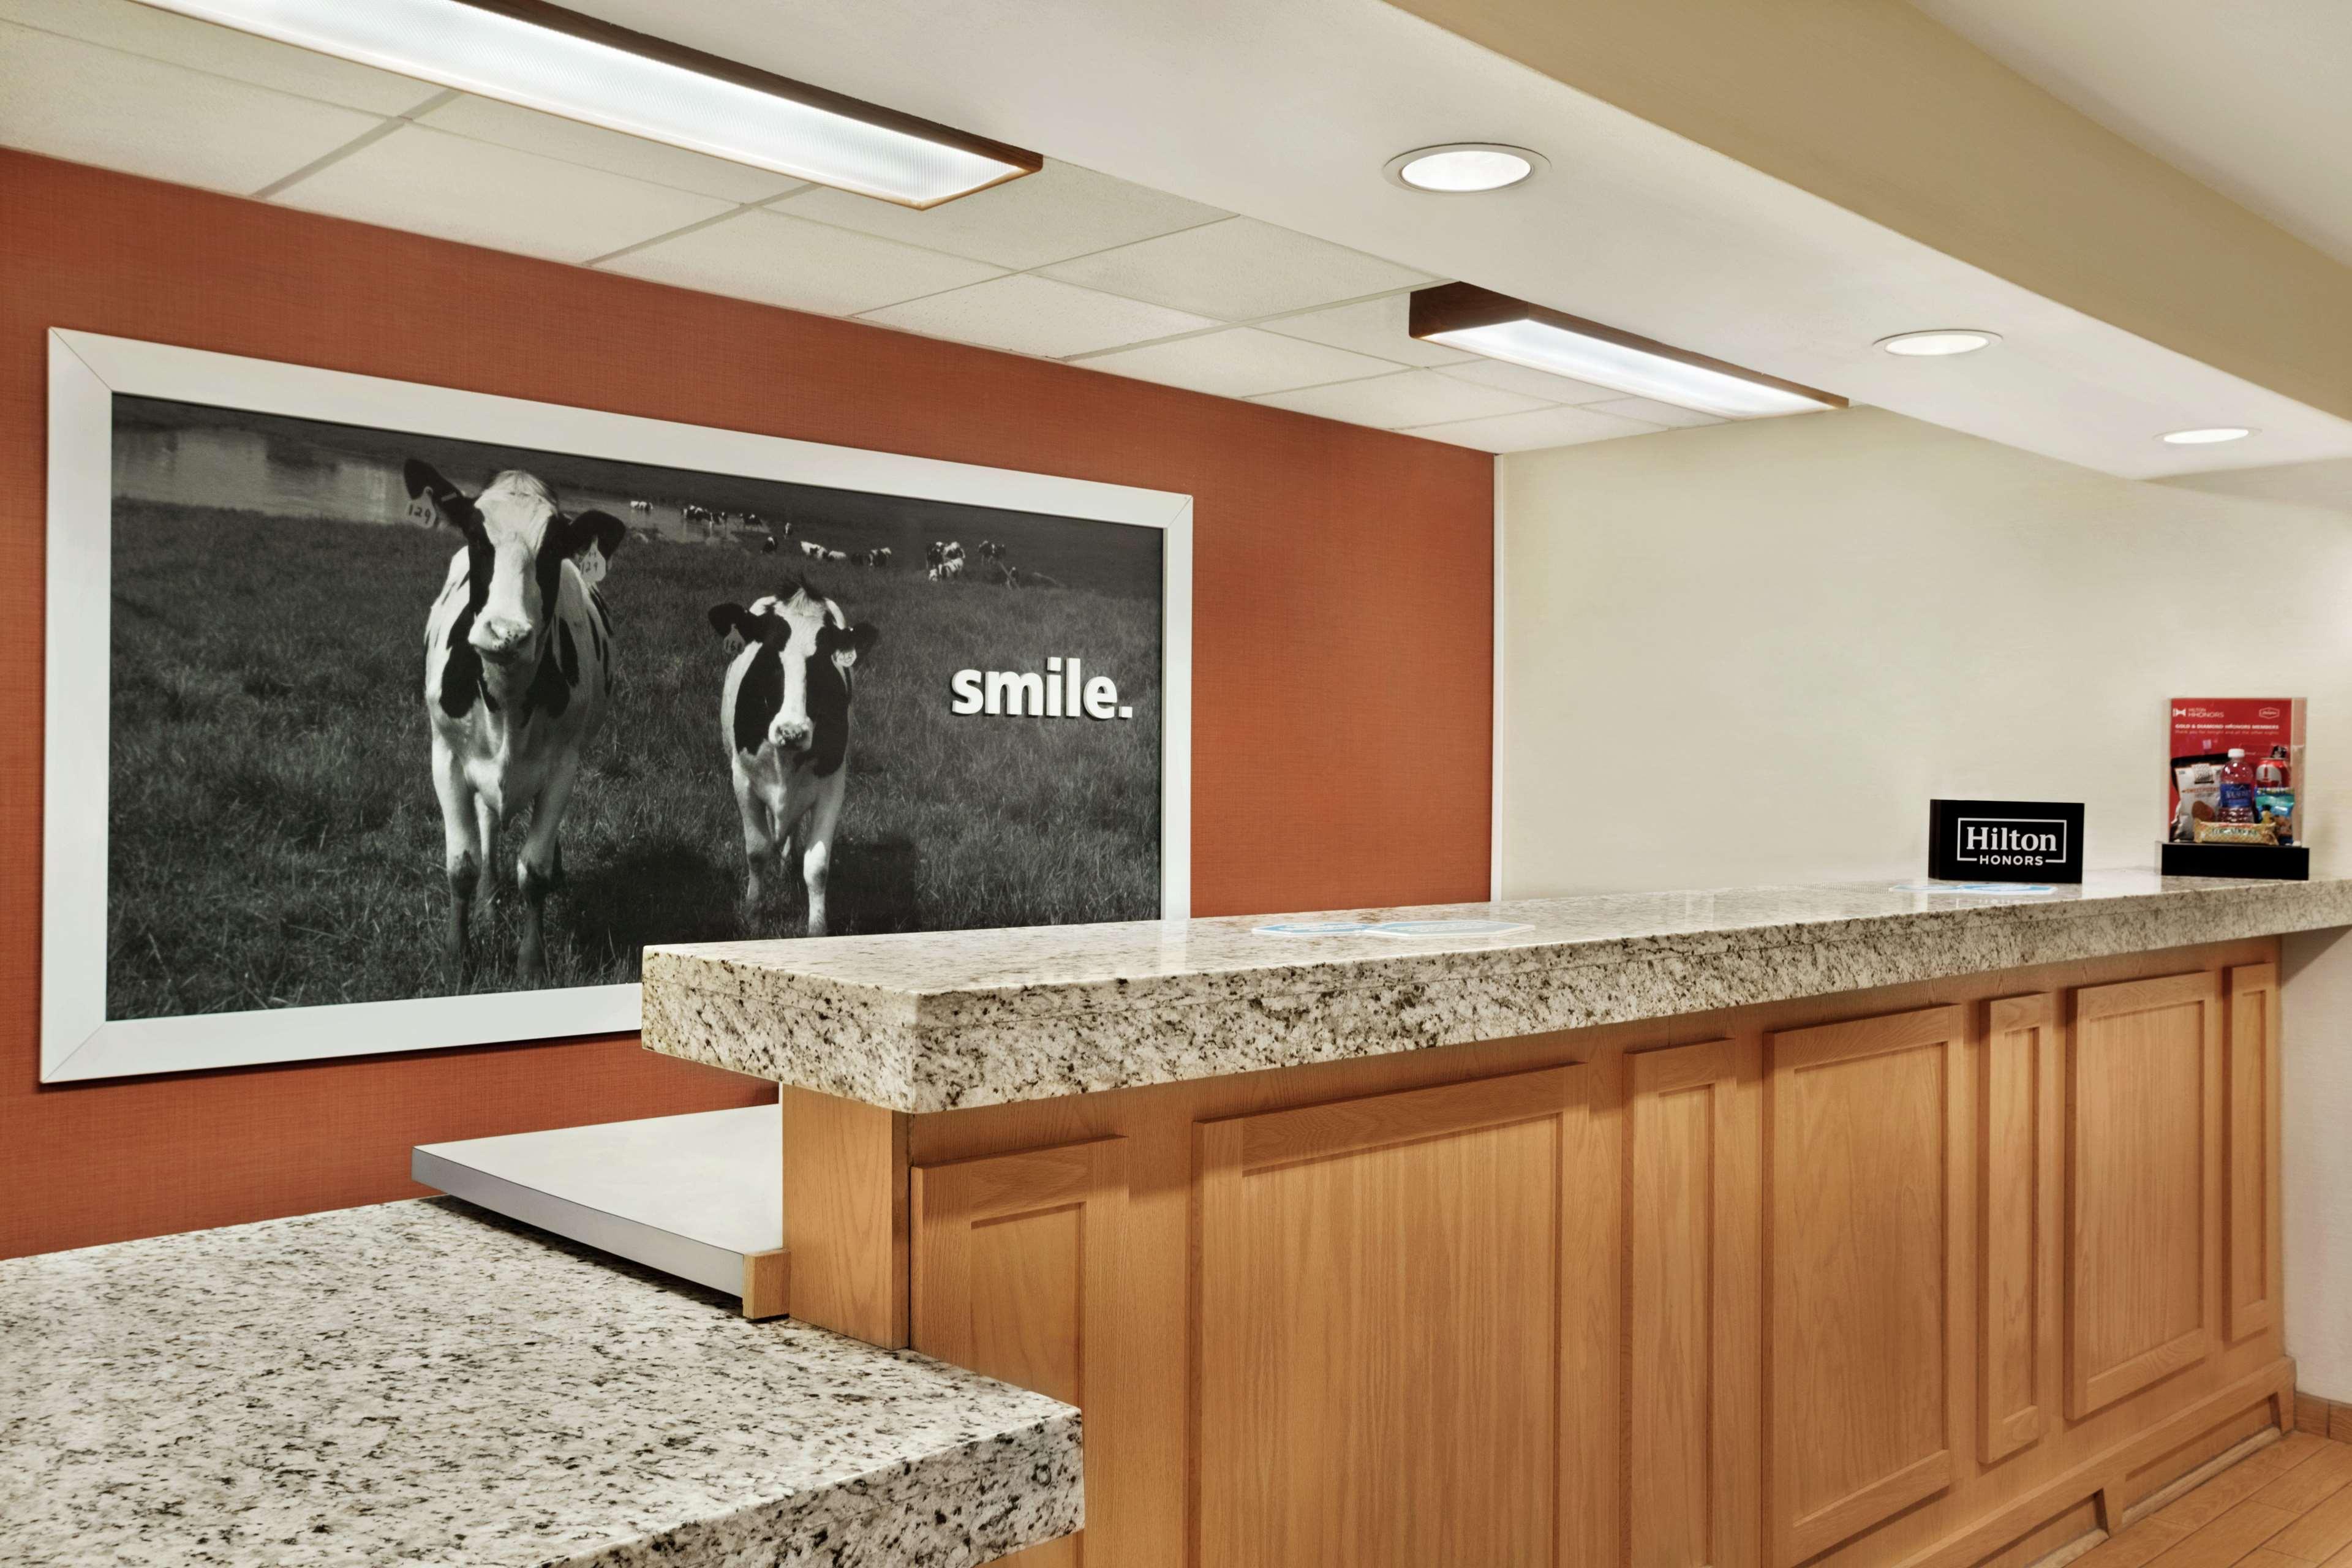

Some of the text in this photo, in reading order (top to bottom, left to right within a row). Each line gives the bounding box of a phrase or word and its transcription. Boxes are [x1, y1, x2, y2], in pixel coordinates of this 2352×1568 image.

[409, 504, 431, 524] 129
[951, 657, 1133, 719] smile.
[1966, 827, 2057, 851] Hilton
[1980, 855, 2044, 866] HONORS
